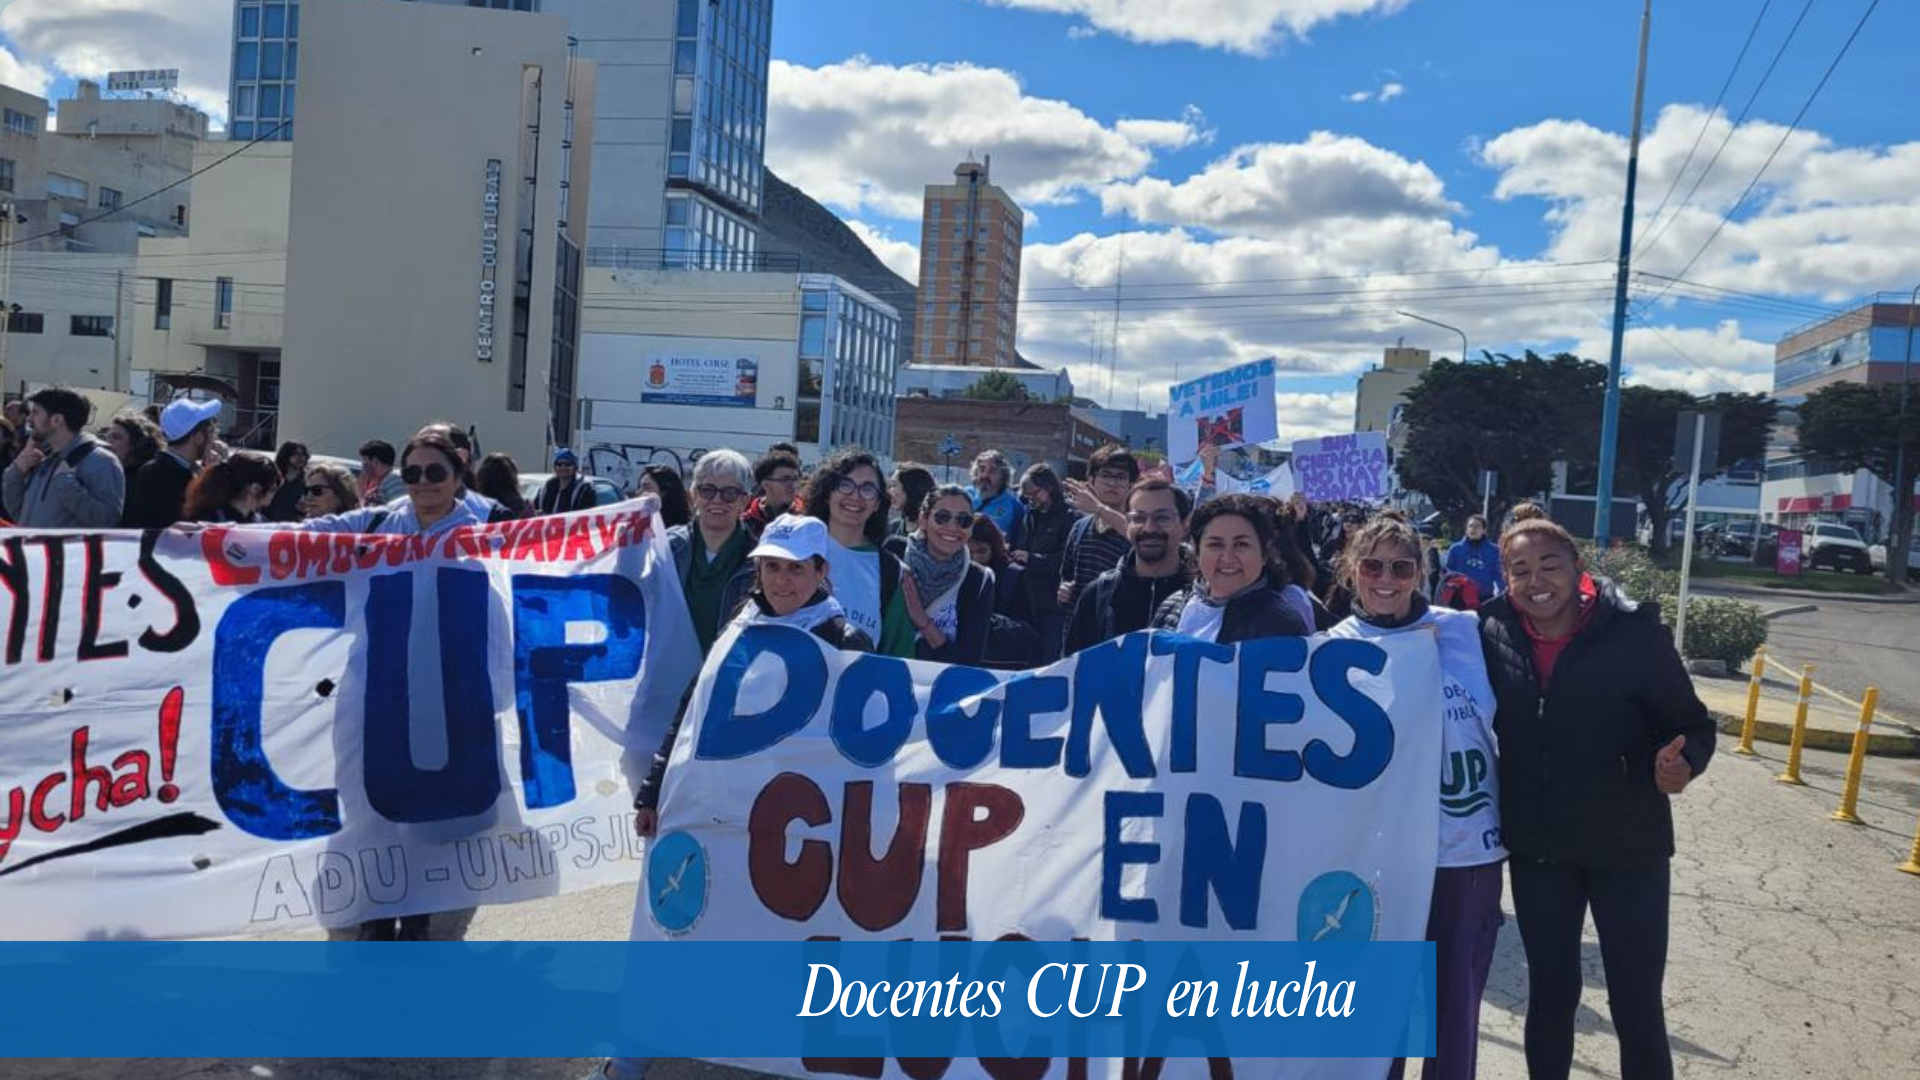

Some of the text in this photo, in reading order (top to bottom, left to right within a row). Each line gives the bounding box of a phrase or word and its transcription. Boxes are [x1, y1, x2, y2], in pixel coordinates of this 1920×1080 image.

[478, 161, 501, 361] CENTRO CULTURAL
[1170, 358, 1274, 401] VETEMOS
[1180, 382, 1259, 417] A MILEI
[1295, 447, 1386, 472] CIENCIA
[1320, 434, 1358, 452] SIN
[1303, 468, 1333, 487] NO
[211, 566, 646, 842] CUP
[695, 624, 1395, 790] DOCENTES
[1443, 684, 1462, 699] DE
[748, 772, 1025, 932] CUP
[1099, 790, 1268, 931] EN
